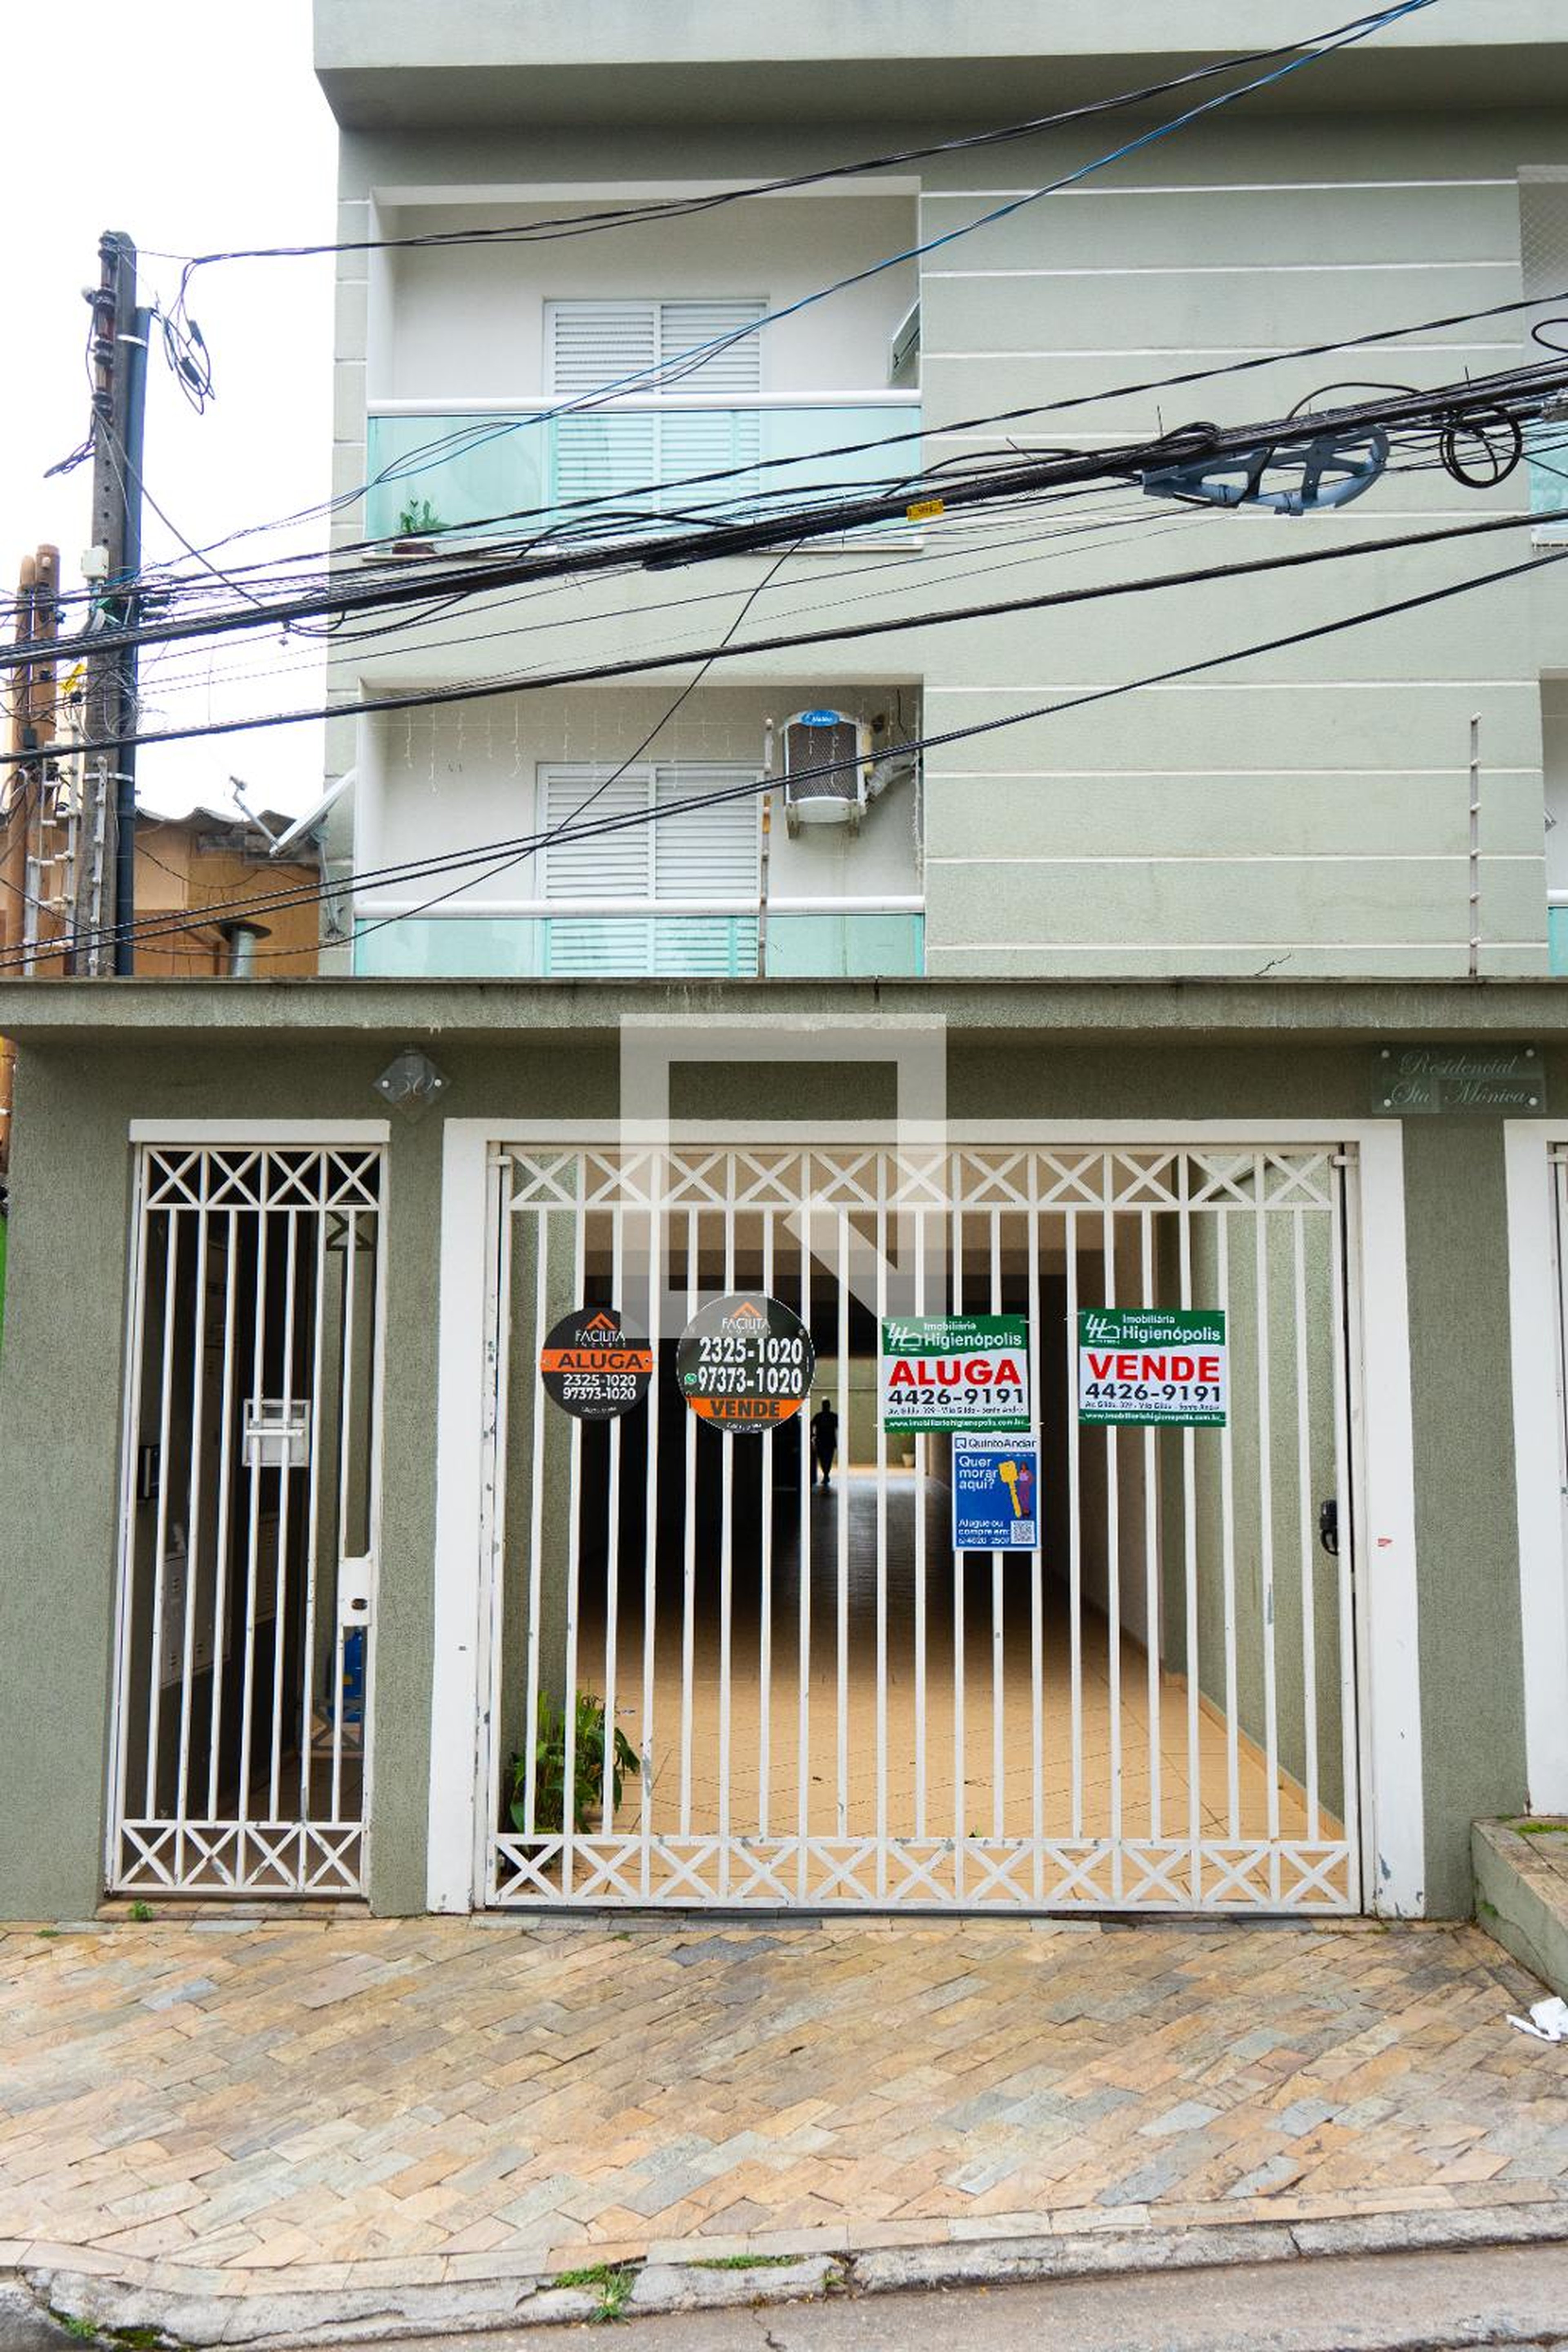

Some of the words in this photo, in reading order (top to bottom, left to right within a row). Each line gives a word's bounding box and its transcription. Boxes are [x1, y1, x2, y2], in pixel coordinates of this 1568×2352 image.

[575, 1330, 626, 1342] FACILITA
[924, 1332, 1022, 1349] Higienópolis
[1123, 1326, 1221, 1343] Higienópolis
[698, 1336, 802, 1364] 2325-1020
[558, 1353, 643, 1369] ALUGA
[1087, 1354, 1219, 1382] VENDE
[563, 1374, 636, 1386] 2325-1020
[698, 1366, 802, 1394] 97373-1020
[889, 1359, 1022, 1386] ALUGA
[563, 1387, 636, 1400] 97373-1020
[888, 1388, 1023, 1405] 4426-9191
[1085, 1383, 1220, 1402] 4426-9191
[710, 1399, 780, 1417] VENDE
[969, 1439, 1037, 1448] QuintoAndar
[959, 1456, 992, 1468] Quer
[959, 1470, 998, 1478] morar
[959, 1478, 995, 1492] aqui?
